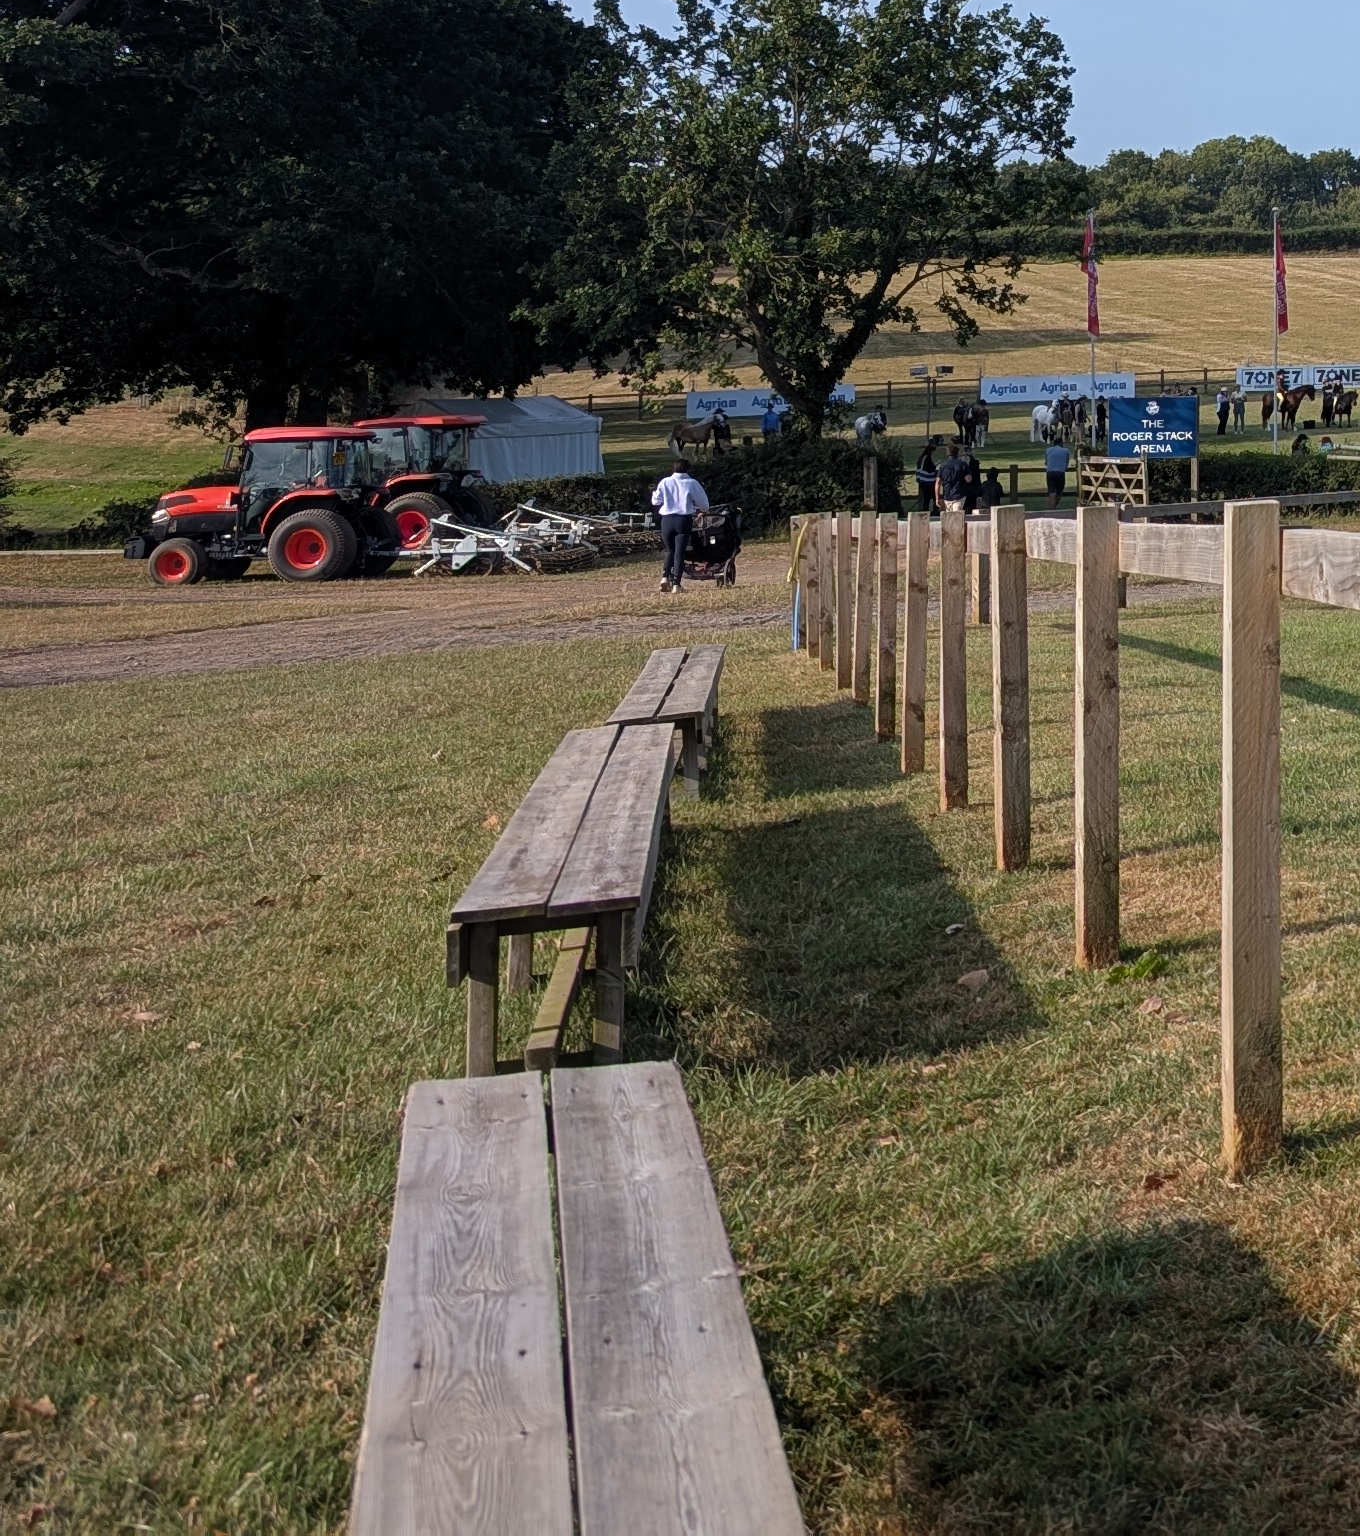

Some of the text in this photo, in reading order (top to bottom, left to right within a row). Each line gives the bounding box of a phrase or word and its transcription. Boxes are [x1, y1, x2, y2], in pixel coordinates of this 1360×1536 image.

[989, 382, 1019, 396] Agria
[1040, 381, 1069, 394] Agria
[696, 397, 728, 411] Agria
[1141, 419, 1165, 429] THE
[1112, 430, 1194, 442] ROGER STACK
[1133, 444, 1172, 453] ARENA
